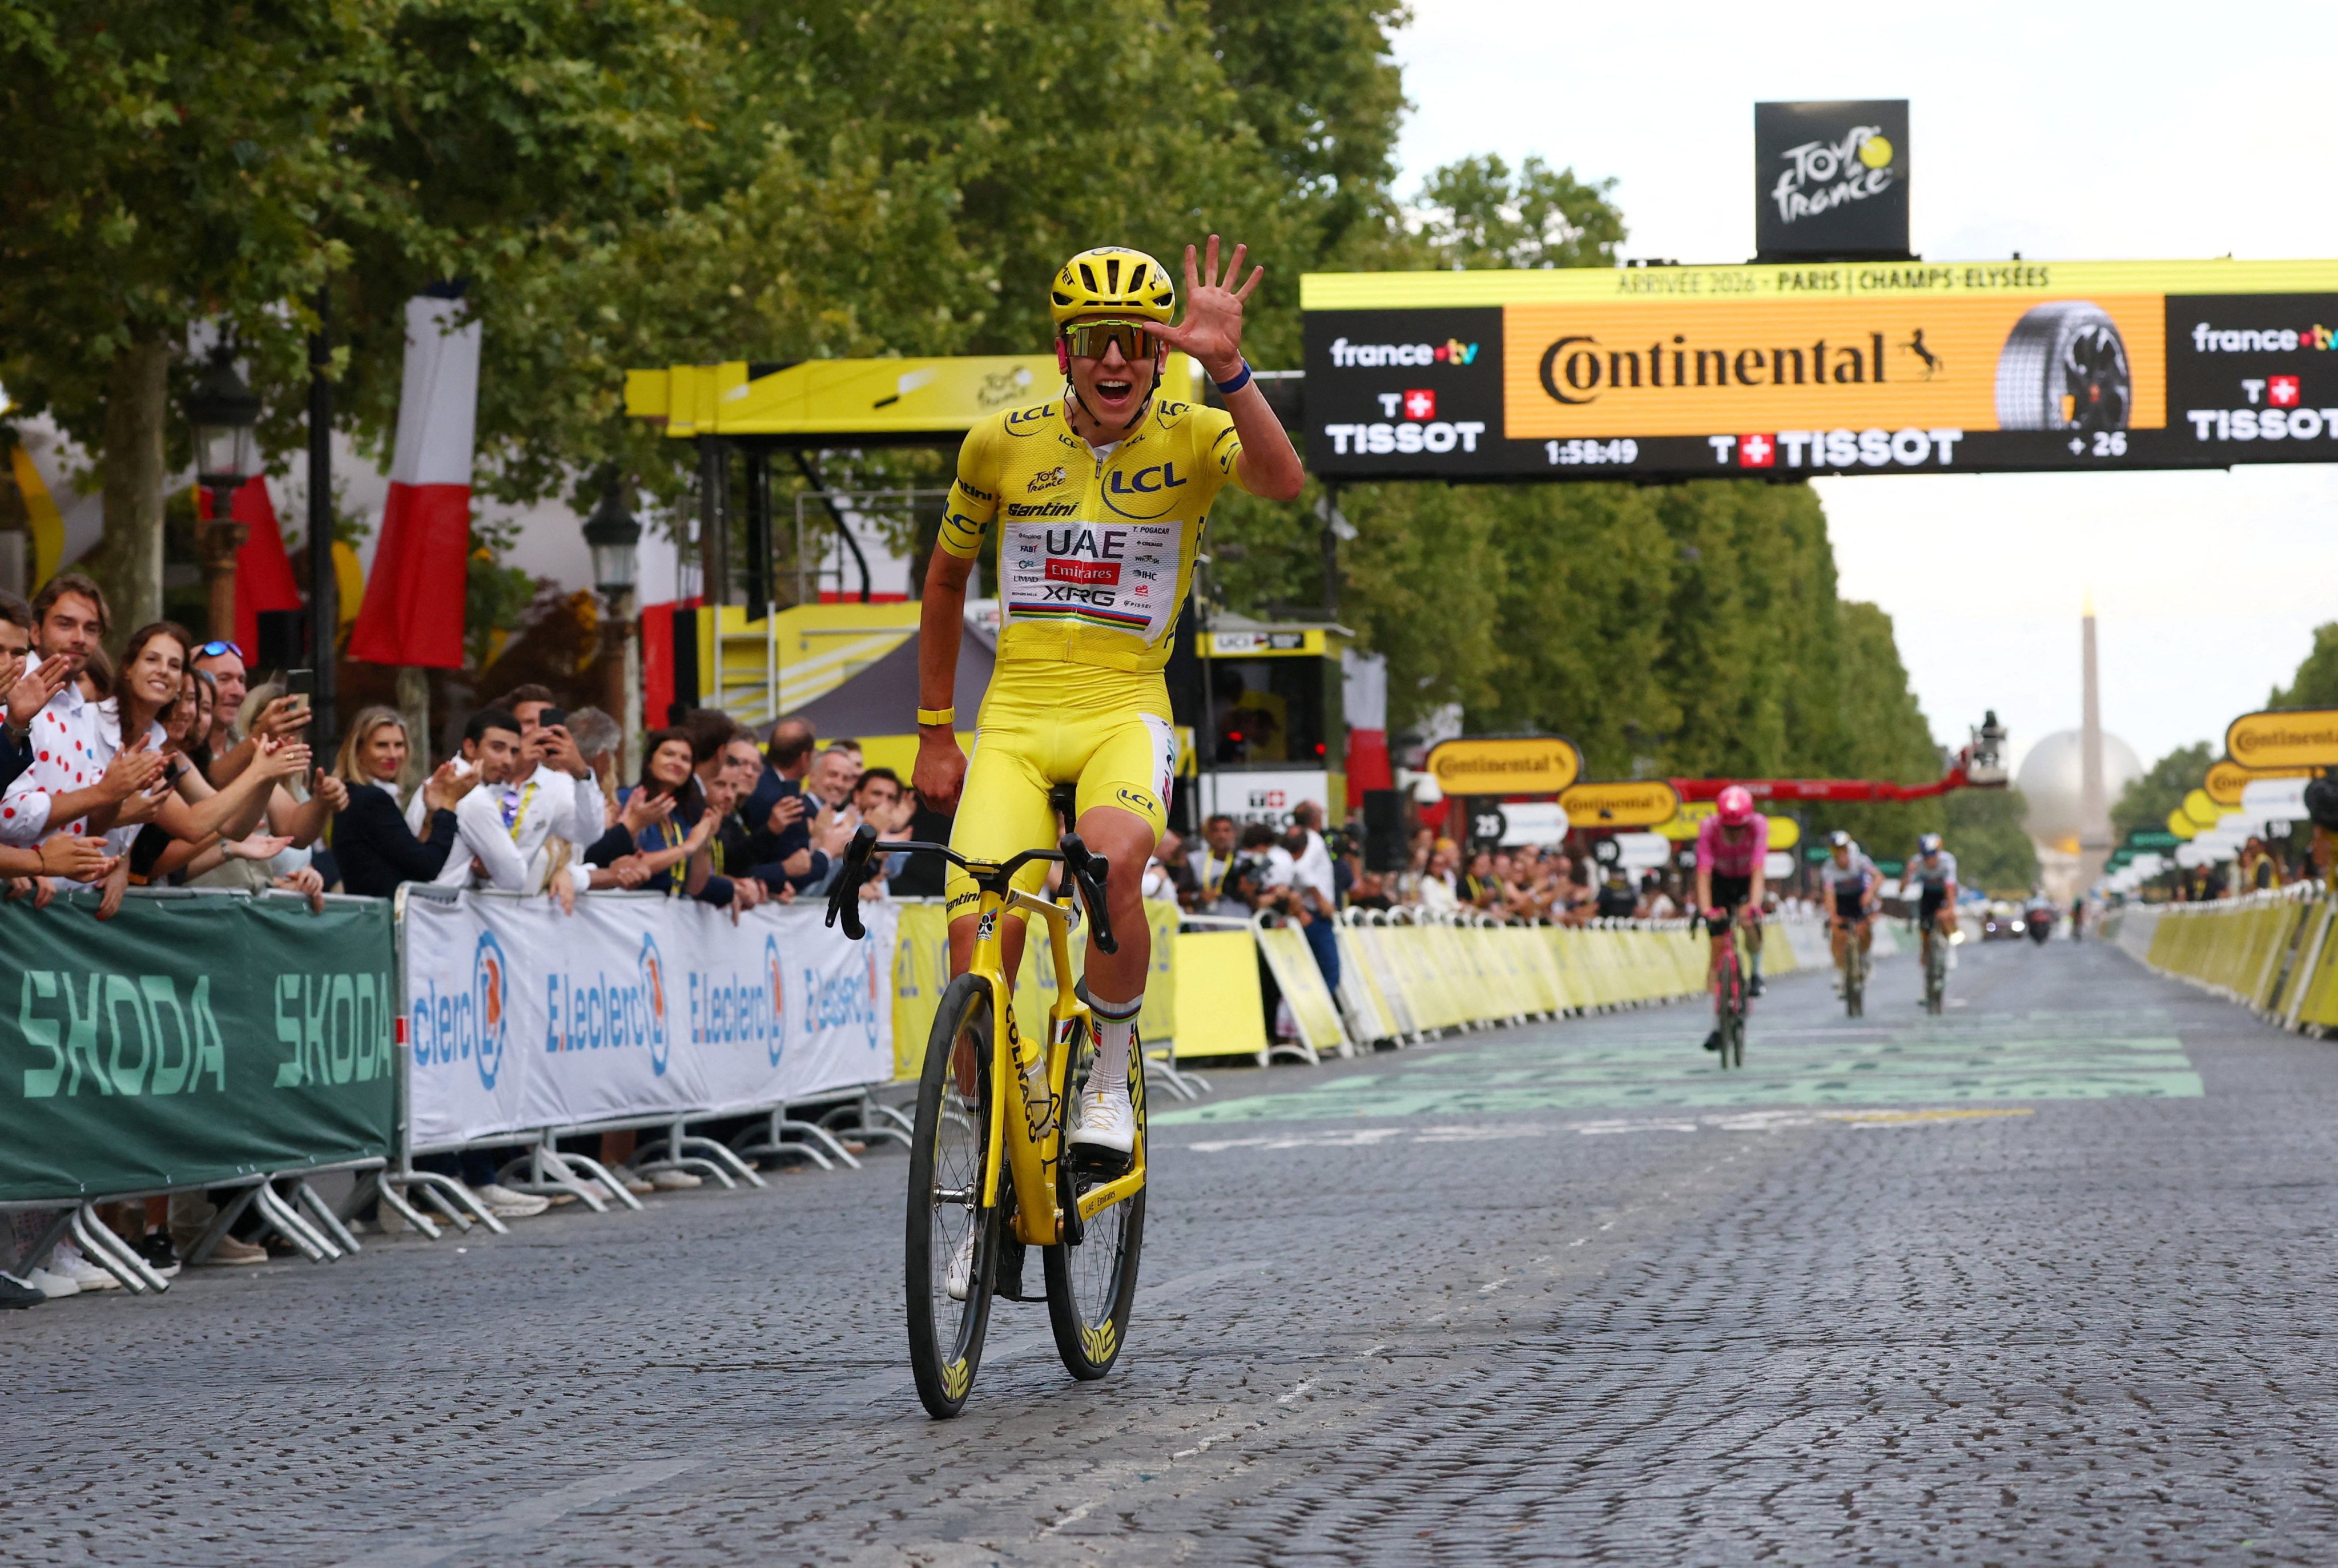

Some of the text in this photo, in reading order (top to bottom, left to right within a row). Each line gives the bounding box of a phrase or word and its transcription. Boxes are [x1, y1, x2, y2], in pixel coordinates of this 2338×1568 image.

[1617, 270, 1701, 295] ARRIVÉE
[1711, 273, 1757, 292] 2026
[1778, 271, 1839, 291] PARIS
[1539, 332, 1886, 405] Continental
[1010, 404, 1055, 424] LCL
[2186, 408, 2338, 442] TISSOT
[1058, 433, 1077, 449] LCL
[1325, 422, 1485, 454] TISSOT
[1777, 428, 1963, 467] TISSOT
[2092, 432, 2128, 457] 26
[1545, 438, 1639, 466] 1:58:49
[1110, 461, 1188, 494] LCL
[1008, 502, 1080, 517] Santini
[1046, 530, 1127, 558] UAE
[1051, 565, 1112, 579] Emirates
[1141, 571, 1157, 581] IHC
[1041, 585, 1116, 607] XRG
[1121, 789, 1156, 816] LCL
[1005, 1003, 1036, 1144] COLNAGO
[1097, 1191, 1116, 1207] Emirates
